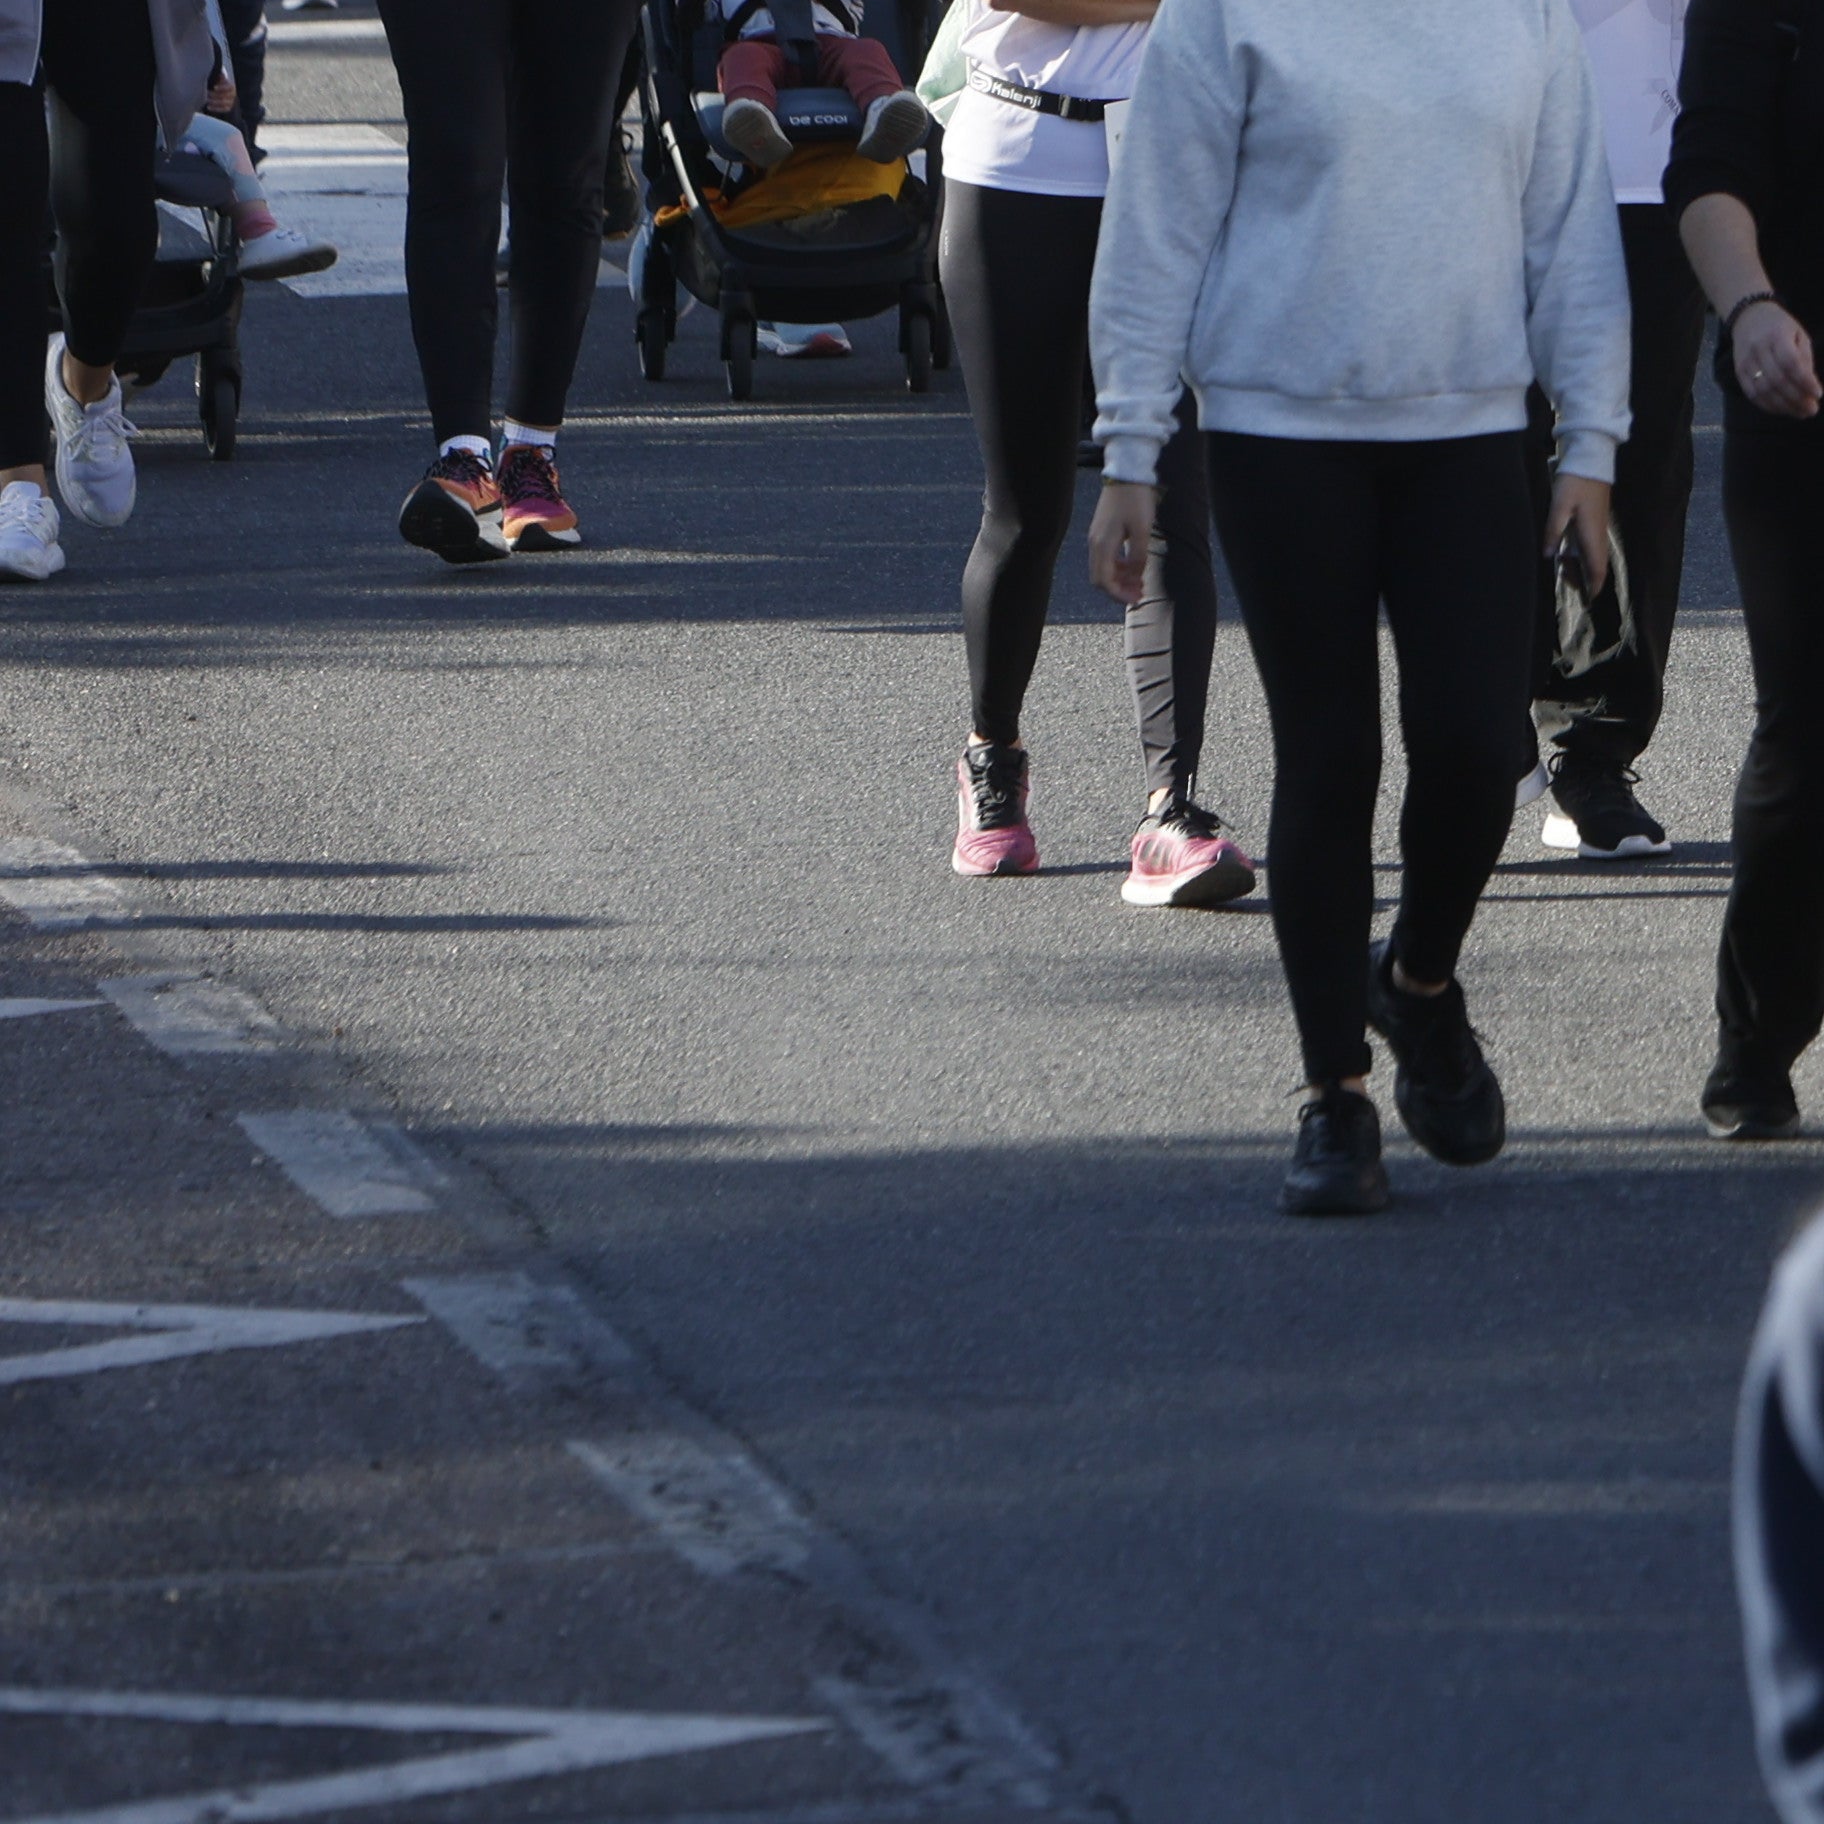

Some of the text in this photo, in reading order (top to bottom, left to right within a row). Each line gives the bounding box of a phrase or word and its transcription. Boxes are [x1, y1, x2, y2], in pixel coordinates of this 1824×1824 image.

[991, 82, 1042, 109] Kalenji
[789, 114, 848, 126] be cool
